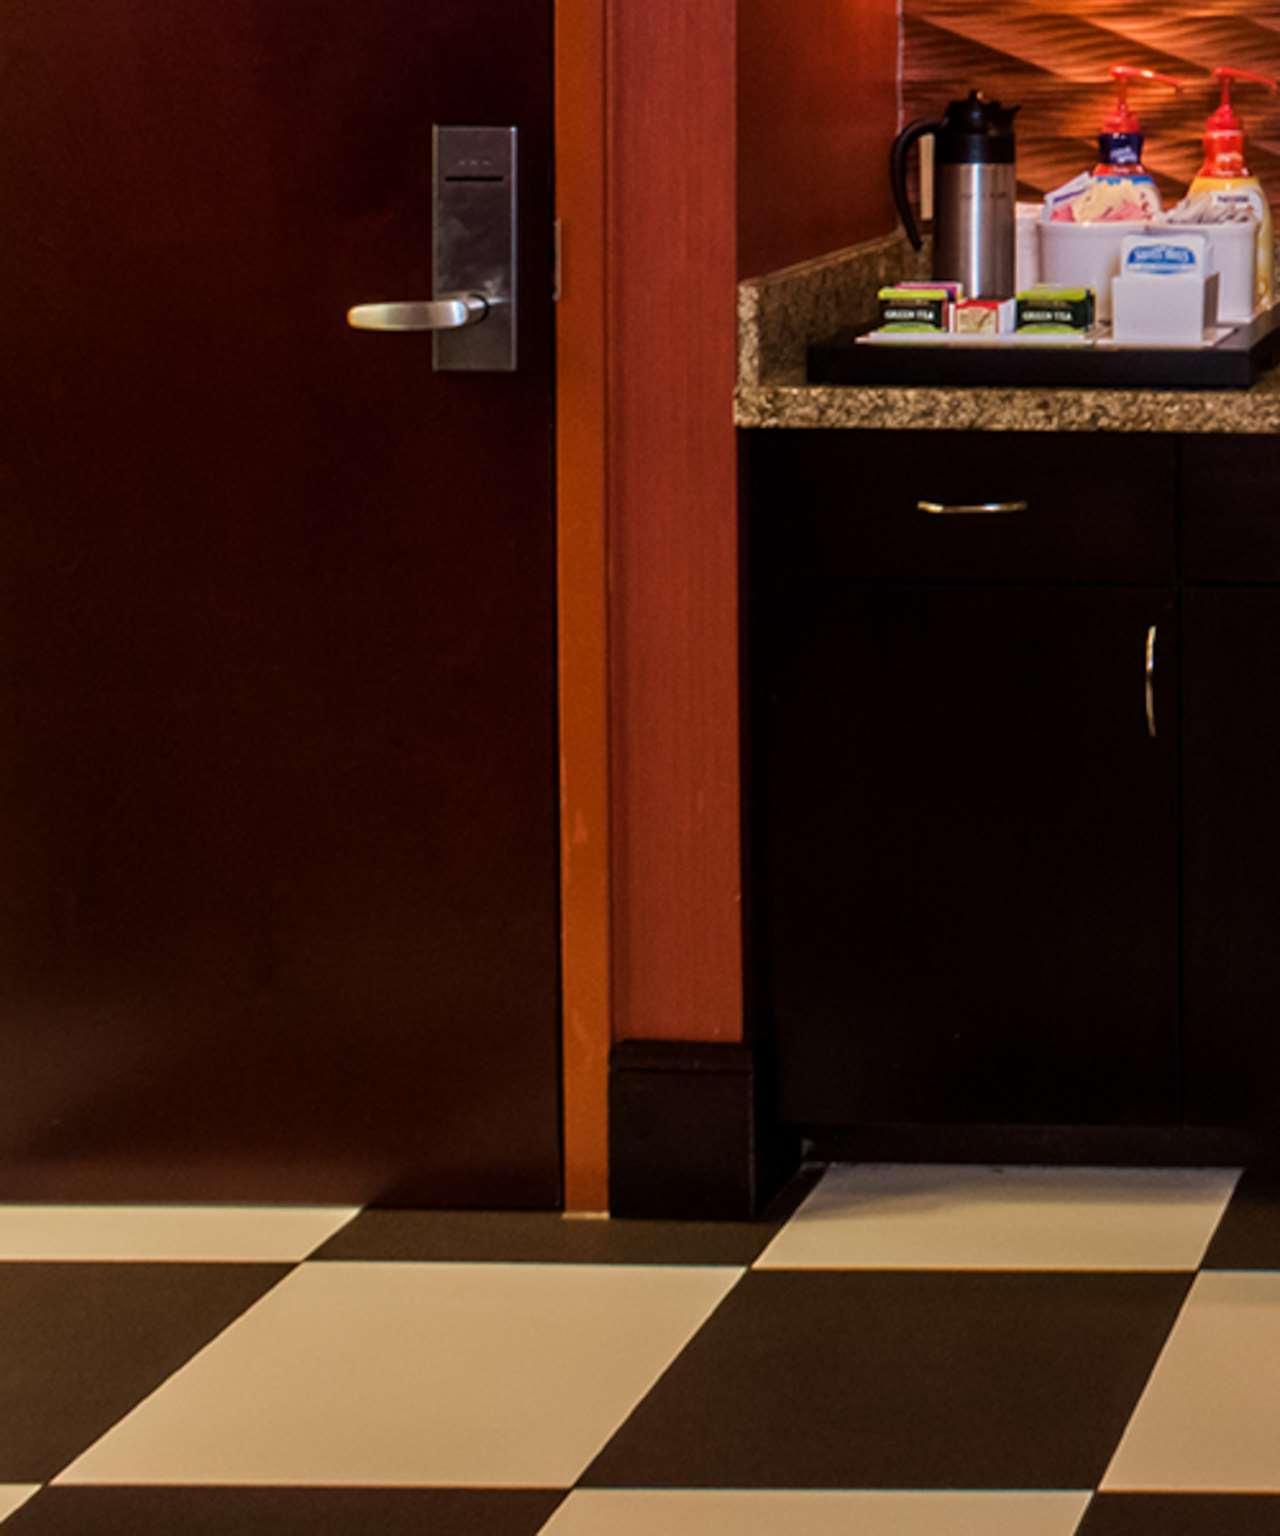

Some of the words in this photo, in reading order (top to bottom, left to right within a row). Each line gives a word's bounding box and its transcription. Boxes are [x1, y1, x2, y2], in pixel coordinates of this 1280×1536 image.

[884, 309, 915, 320] GREEN
[916, 309, 935, 320] TEA
[1022, 310, 1053, 321] GREEN
[1054, 310, 1074, 321] TEA
